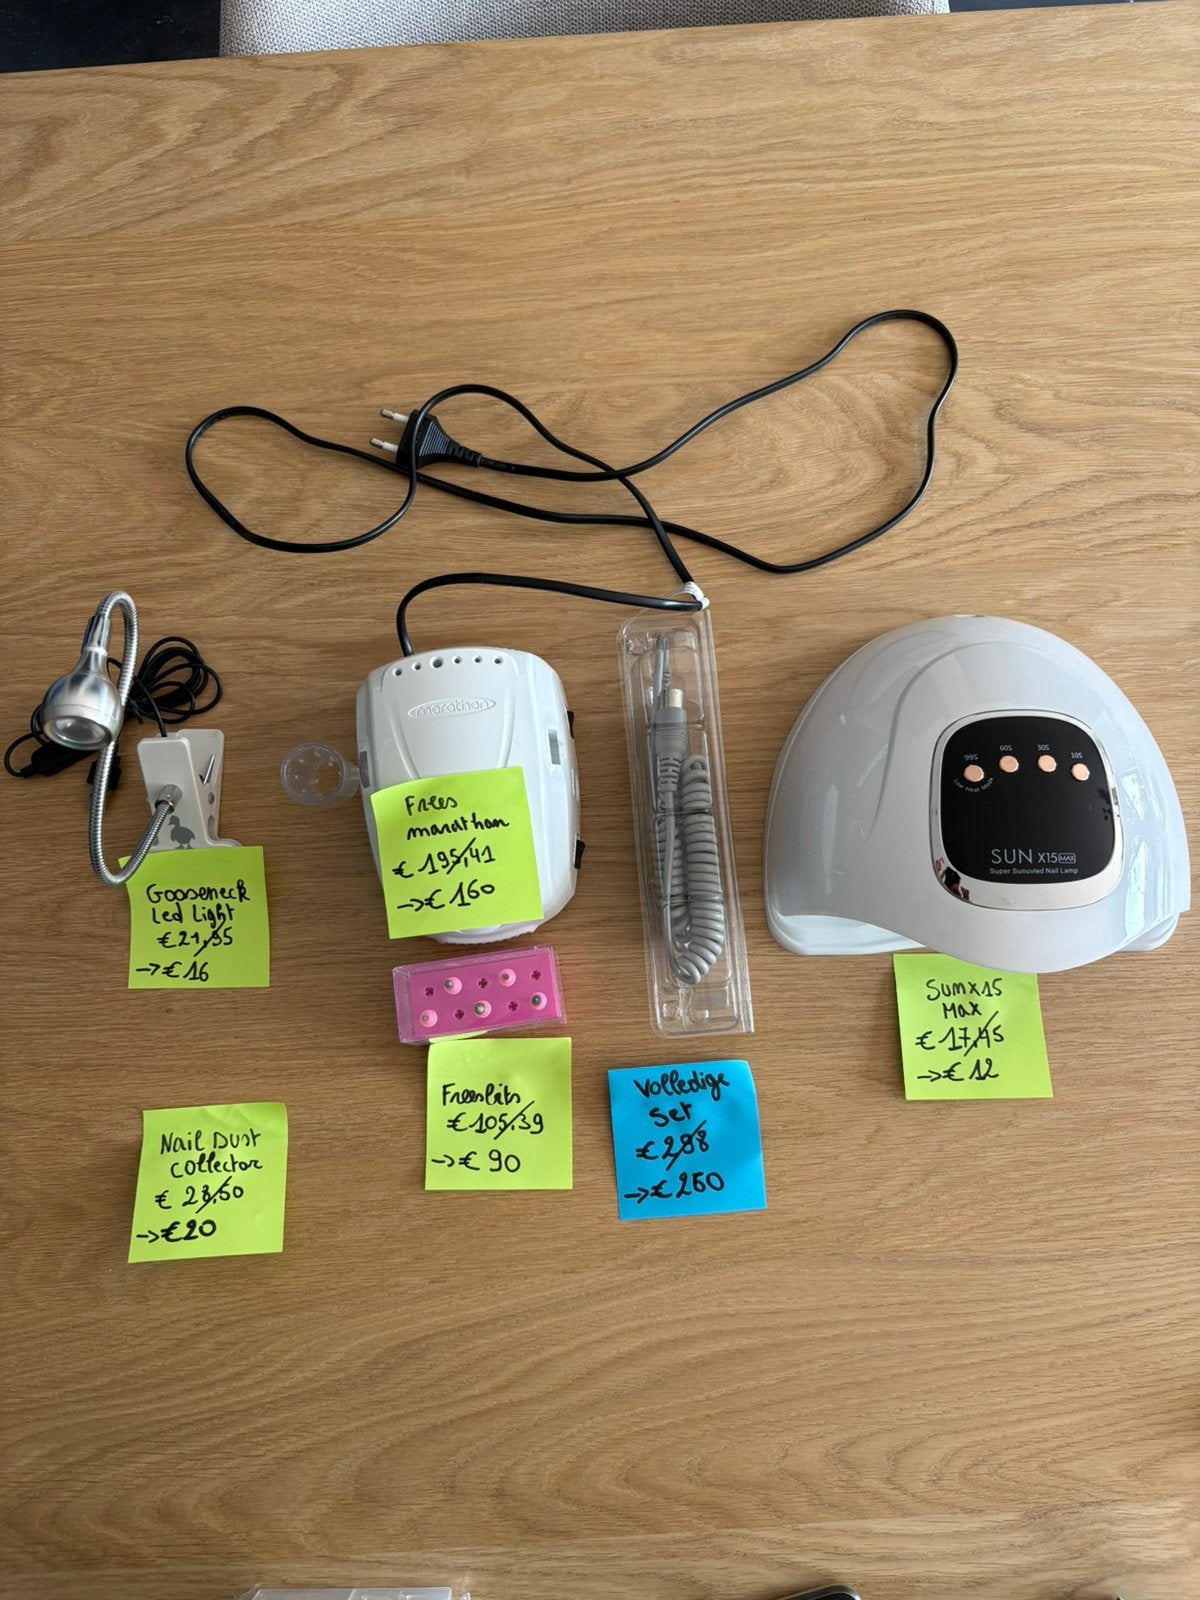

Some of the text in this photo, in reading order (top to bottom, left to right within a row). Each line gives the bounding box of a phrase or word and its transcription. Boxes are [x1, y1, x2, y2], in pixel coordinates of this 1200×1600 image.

[416, 699, 490, 717] marathon
[1000, 744, 1013, 752] 60S
[404, 795, 458, 816] Frees
[991, 848, 1033, 864] SUN
[1059, 854, 1075, 863] MAX
[989, 867, 1011, 875] Super
[1060, 867, 1079, 875] Lamp
[146, 879, 251, 903] Gooseneck
[193, 903, 235, 928] Light
[632, 1069, 730, 1101] Volledige
[648, 1101, 693, 1128] Set
[160, 1130, 205, 1155] Nail
